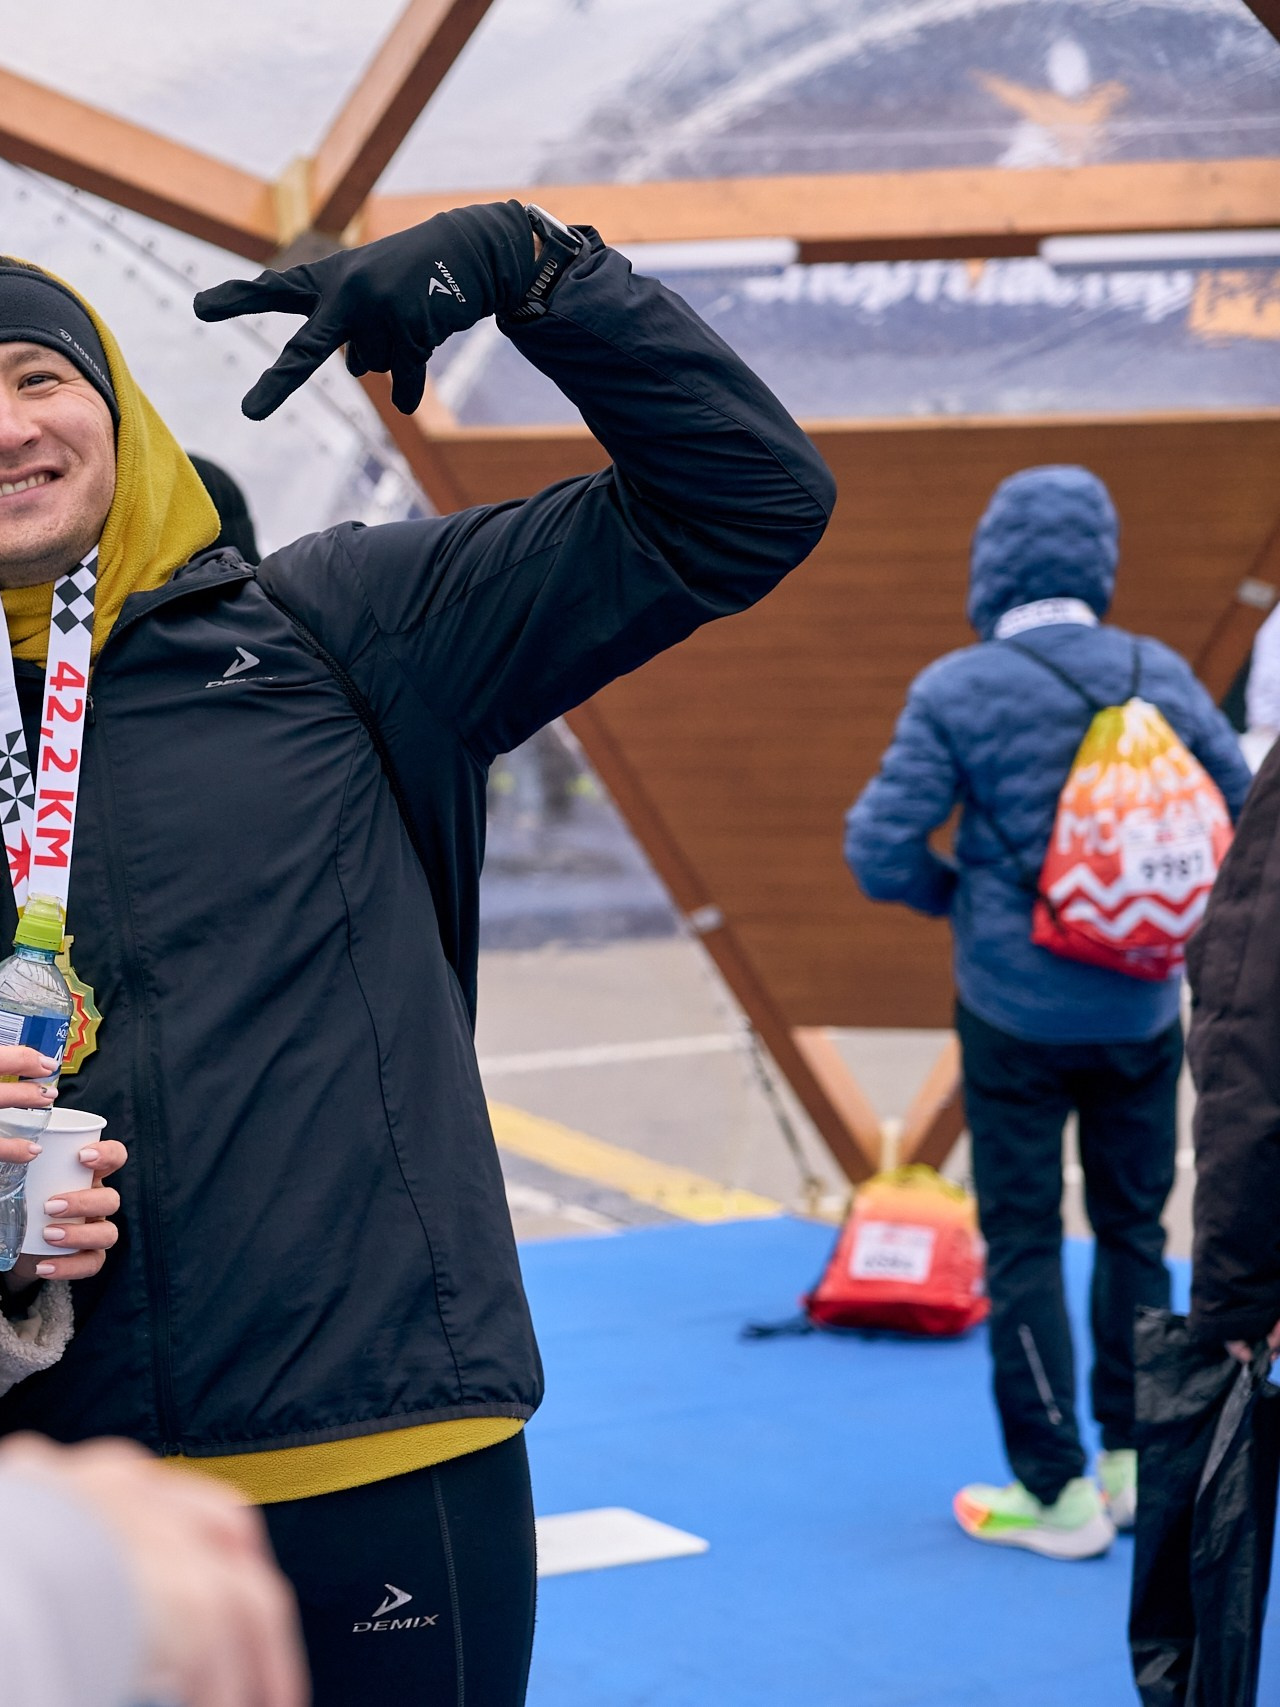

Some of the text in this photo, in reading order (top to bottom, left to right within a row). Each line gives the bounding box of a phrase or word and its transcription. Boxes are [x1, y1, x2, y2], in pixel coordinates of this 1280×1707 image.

[434, 261, 467, 303] DEMIX
[33, 661, 86, 868] 42,2 KM
[352, 1614, 440, 1633] DEMIX
